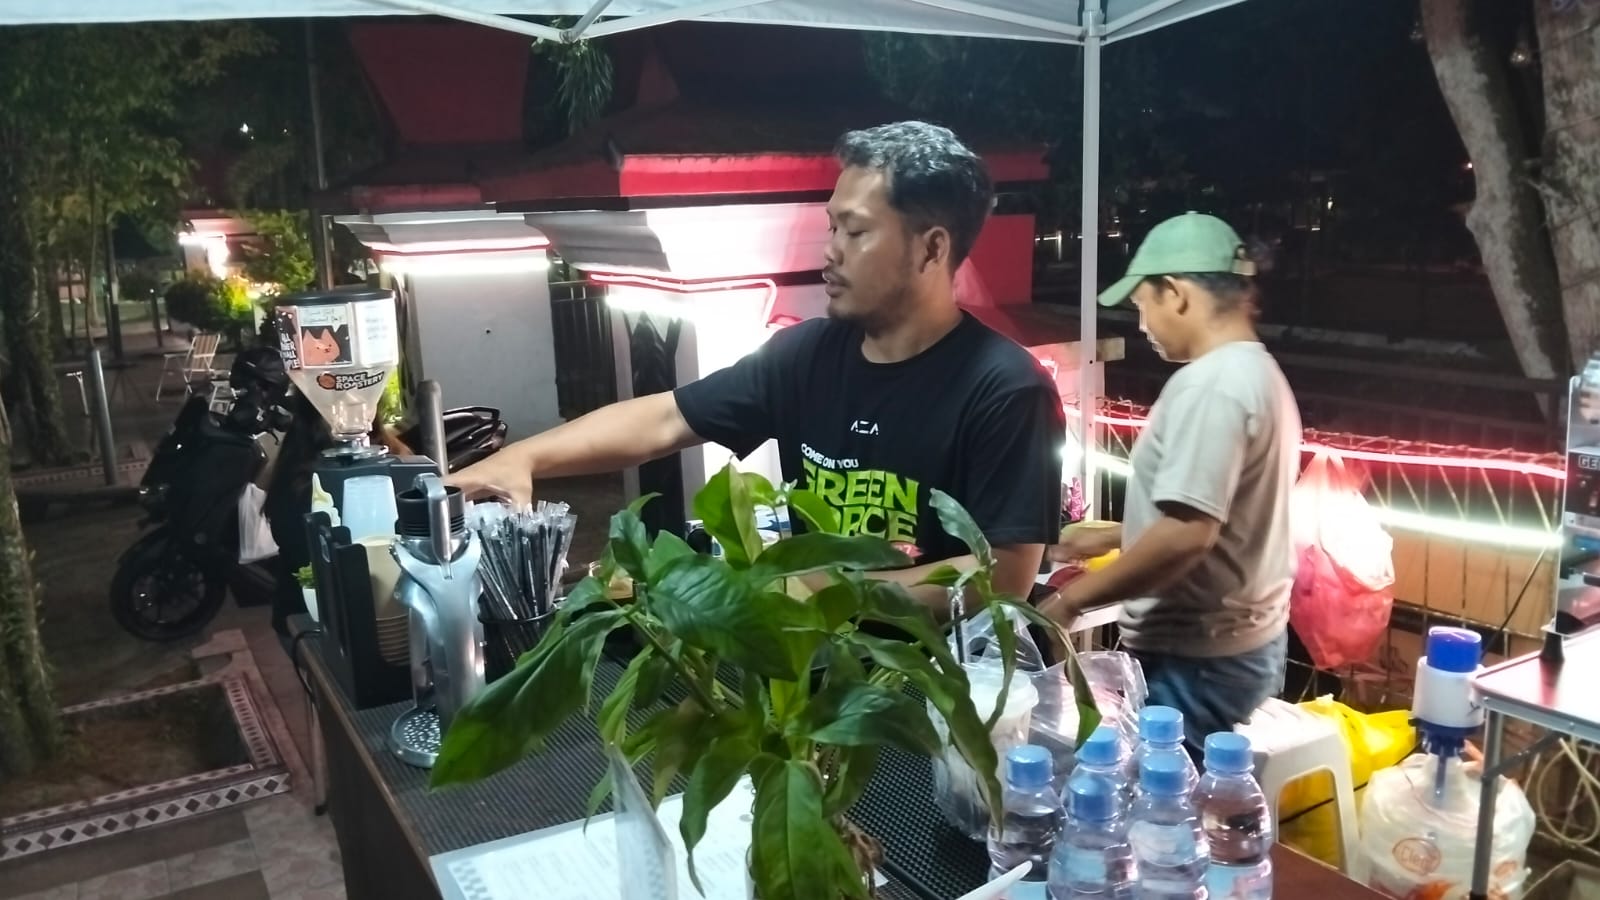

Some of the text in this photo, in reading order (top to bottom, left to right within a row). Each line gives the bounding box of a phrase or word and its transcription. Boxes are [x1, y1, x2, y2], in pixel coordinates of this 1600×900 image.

[336, 373, 367, 383] SPACE
[336, 374, 384, 390] ROASTERY
[801, 443, 859, 469] COME ON YOU
[802, 458, 919, 514] GREEN
[840, 506, 918, 544] RCE
